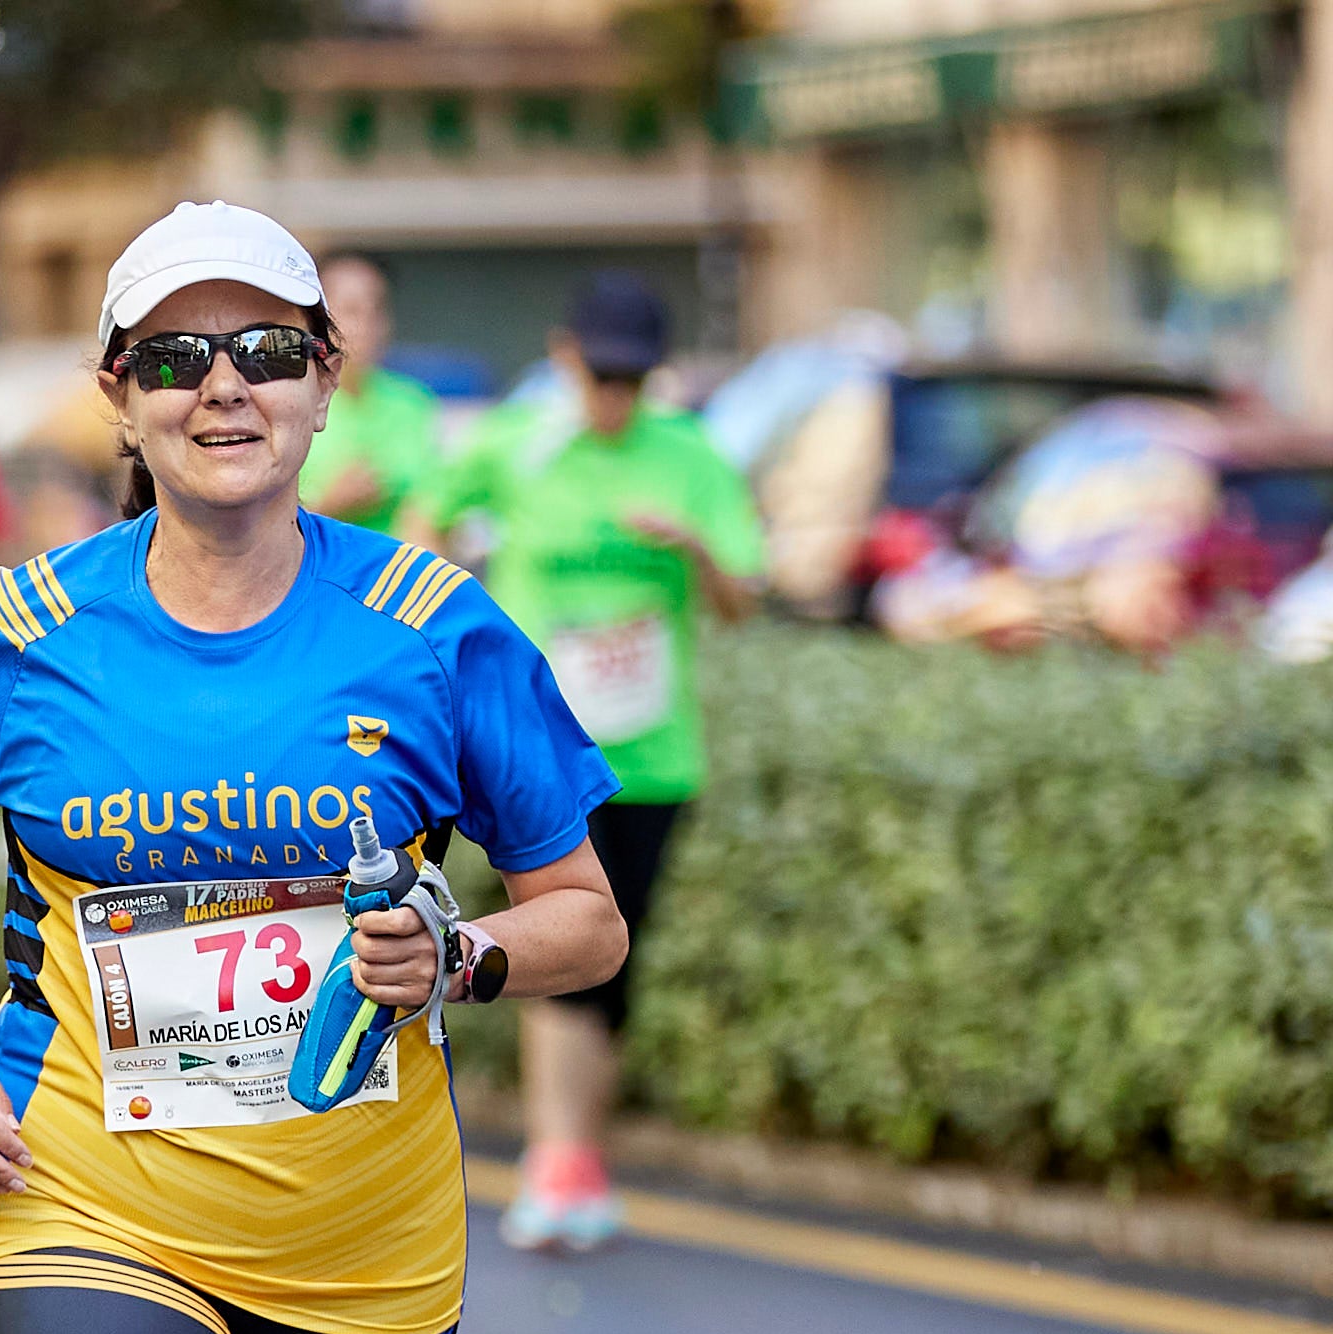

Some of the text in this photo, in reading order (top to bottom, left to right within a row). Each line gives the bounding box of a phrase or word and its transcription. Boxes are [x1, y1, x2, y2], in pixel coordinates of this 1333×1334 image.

[61, 771, 372, 853] agustinos
[115, 844, 330, 873] GRANADA
[214, 882, 270, 892] MEMORIAL
[309, 879, 346, 889] OXIM
[106, 894, 168, 911] OXIMESA
[185, 885, 214, 907] 17
[216, 887, 267, 903] PADRE
[140, 903, 169, 916] GASES
[184, 896, 274, 923] MARCELINO
[194, 922, 312, 1012] 73
[104, 963, 131, 1031] CAJÓN 4
[149, 1020, 211, 1045] MARÍA
[214, 1021, 240, 1042] DE
[244, 1013, 282, 1039] LOS
[117, 1058, 167, 1068] CALERO
[242, 1048, 284, 1061] OXIMESA
[233, 1085, 285, 1097] MASTER 55
